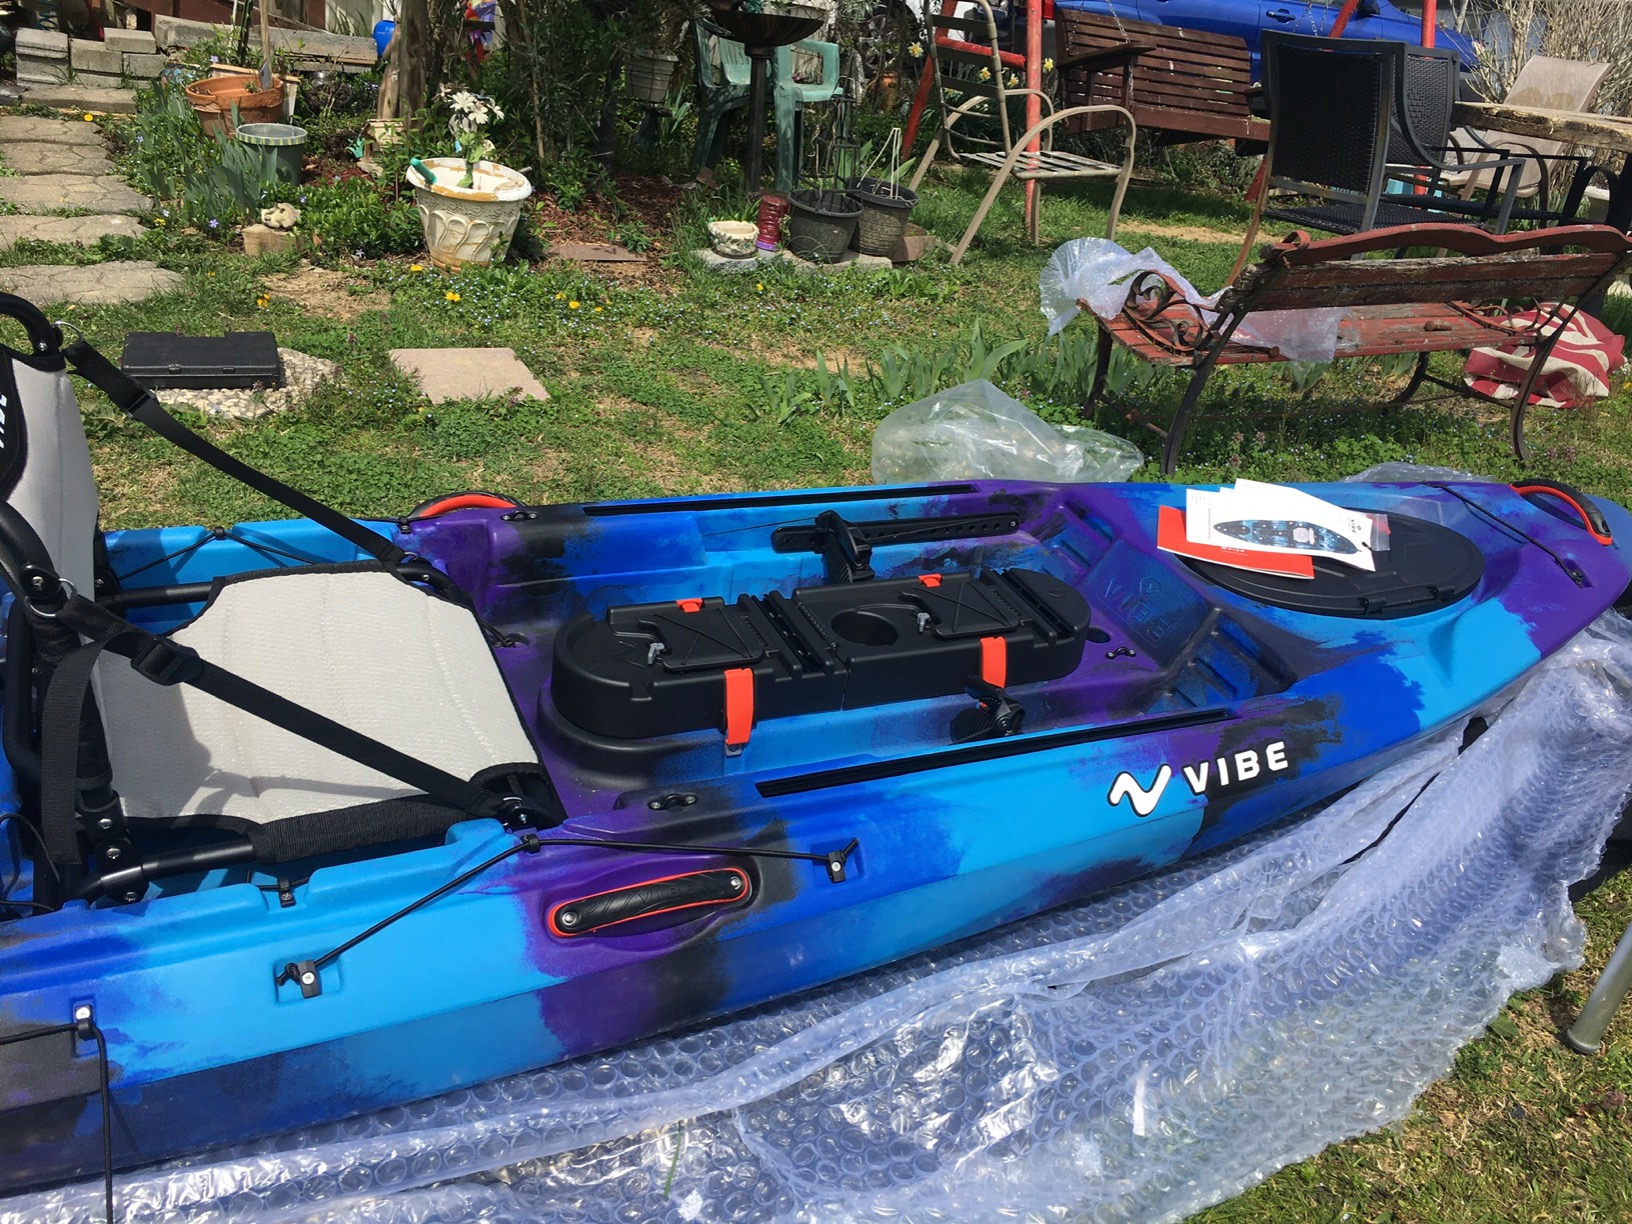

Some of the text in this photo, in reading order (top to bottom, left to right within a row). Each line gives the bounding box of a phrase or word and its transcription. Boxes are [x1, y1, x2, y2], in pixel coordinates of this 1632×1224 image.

[1103, 579, 1170, 640] VIBE
[1183, 741, 1289, 794] VIBE
[637, 883, 697, 904] VIBE
